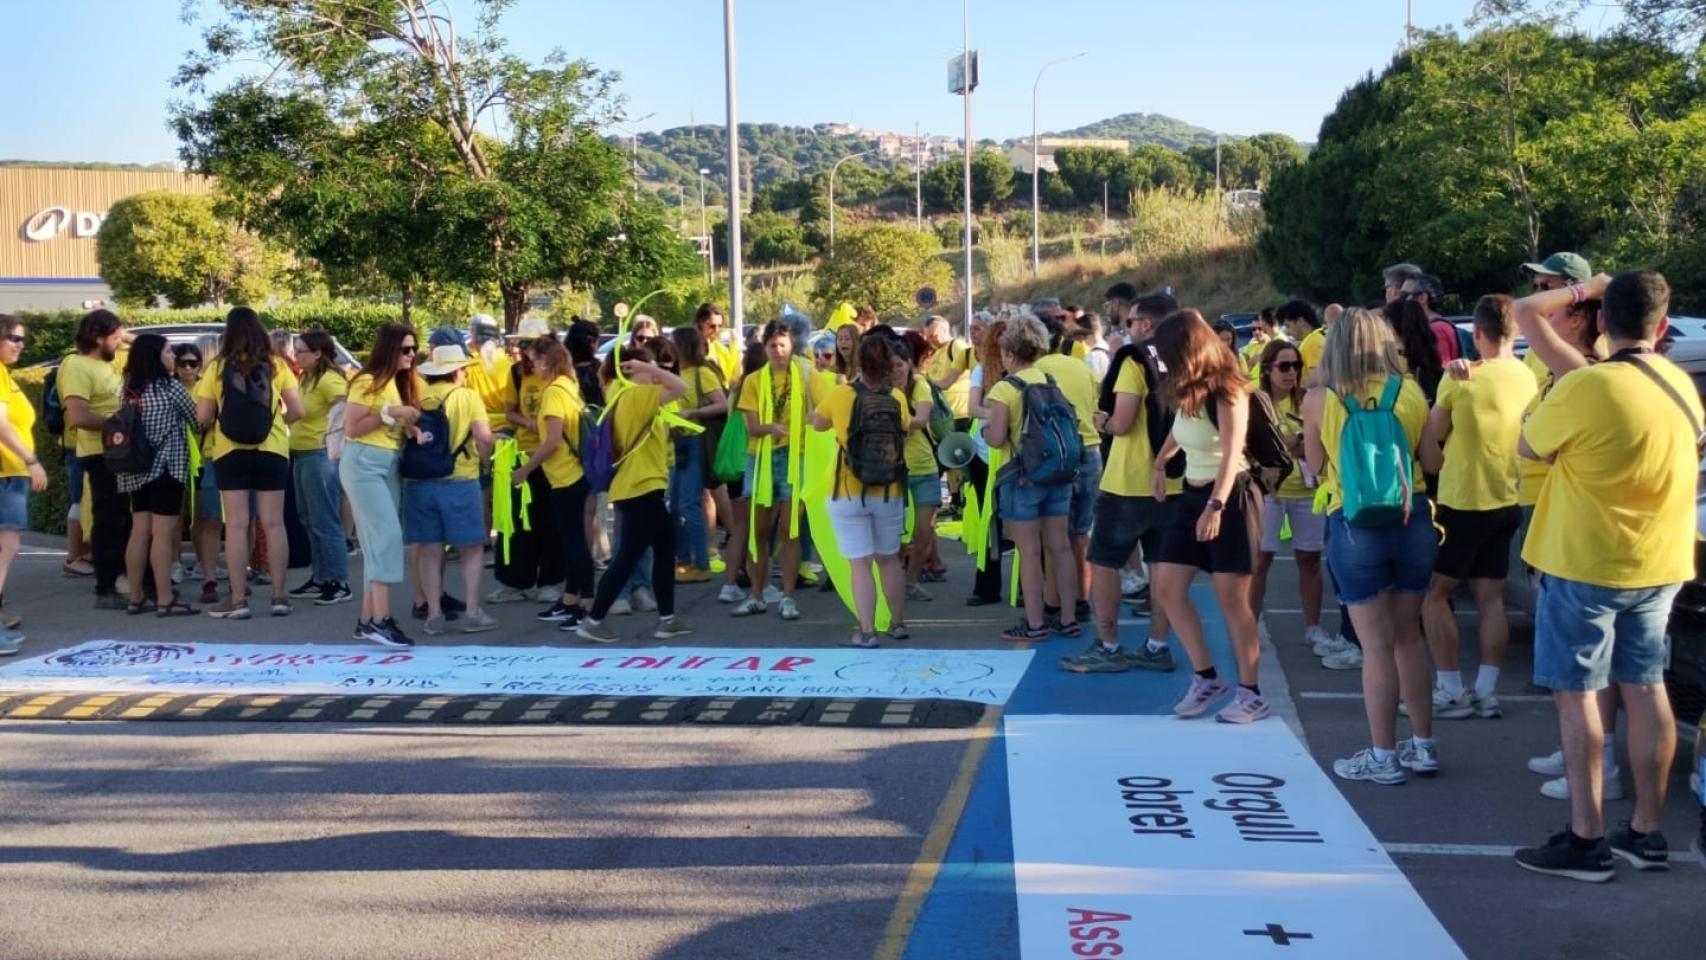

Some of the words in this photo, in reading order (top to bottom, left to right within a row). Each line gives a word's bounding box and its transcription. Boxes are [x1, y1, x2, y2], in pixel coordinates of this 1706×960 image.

[76, 211, 108, 237] D
[1117, 776, 1195, 839] obrer
[1203, 772, 1325, 843] Orgull
[1066, 907, 1132, 960] Ass
